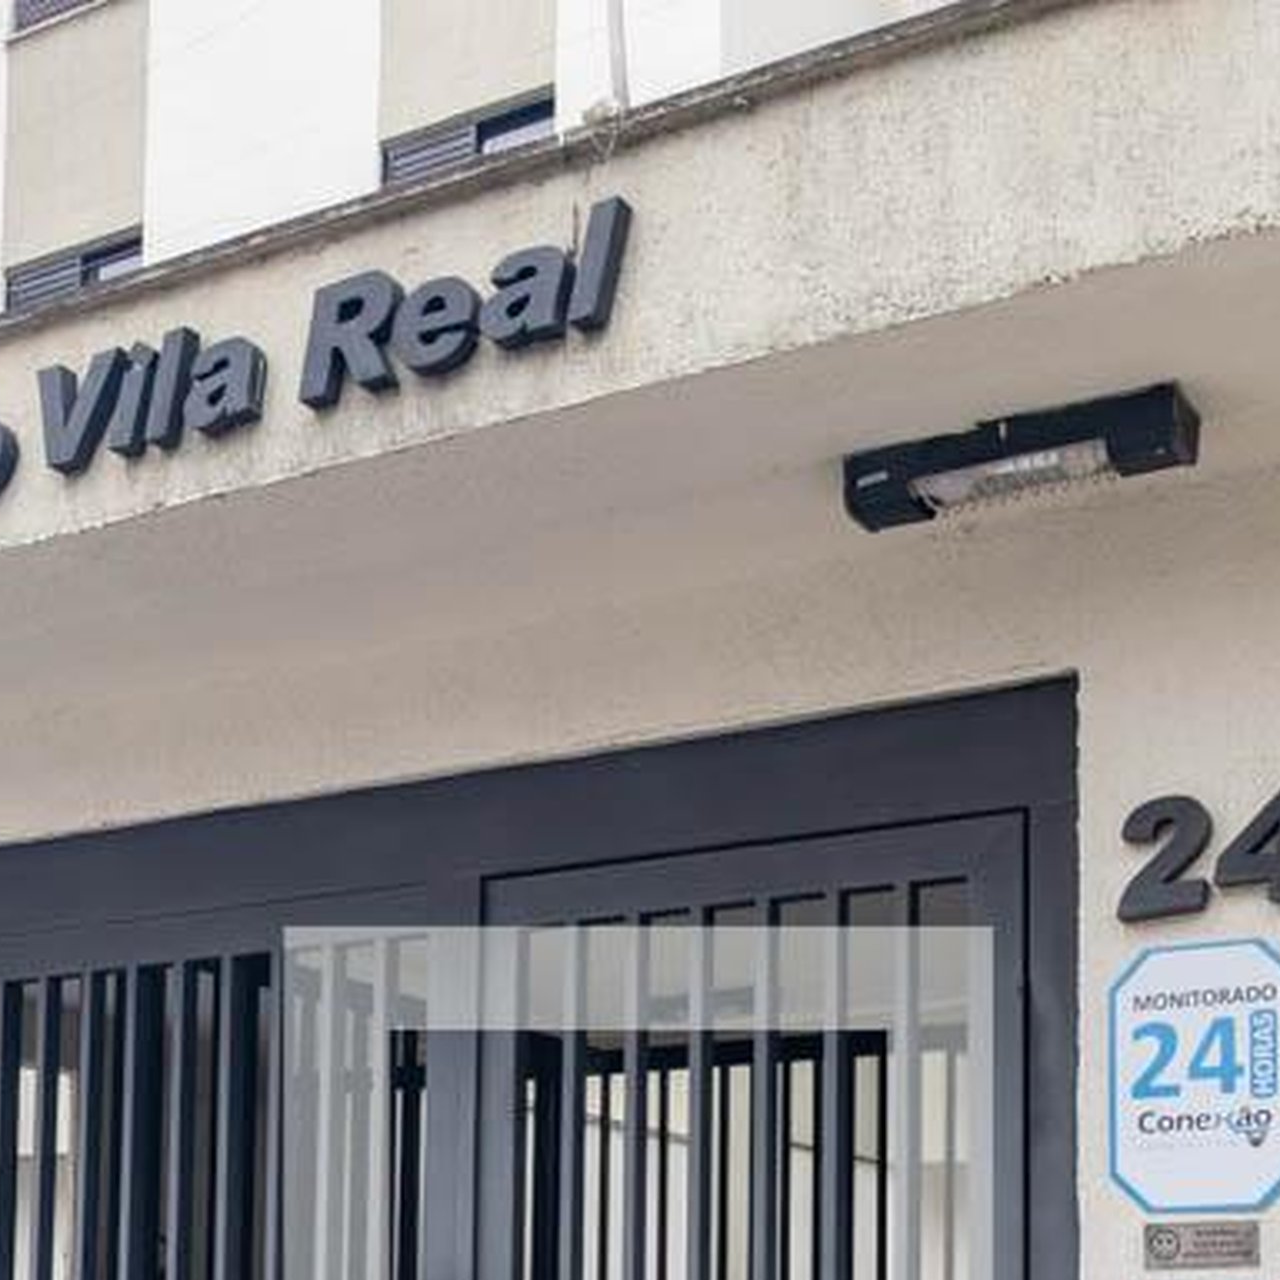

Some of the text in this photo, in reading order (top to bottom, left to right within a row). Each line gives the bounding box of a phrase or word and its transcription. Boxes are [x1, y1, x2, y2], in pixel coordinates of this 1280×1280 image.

[36, 325, 268, 476] Vila
[299, 196, 633, 411] Real
[1132, 982, 1278, 1013] MONITORADO
[1131, 1015, 1245, 1099] 24
[1251, 1012, 1277, 1097] HORAS
